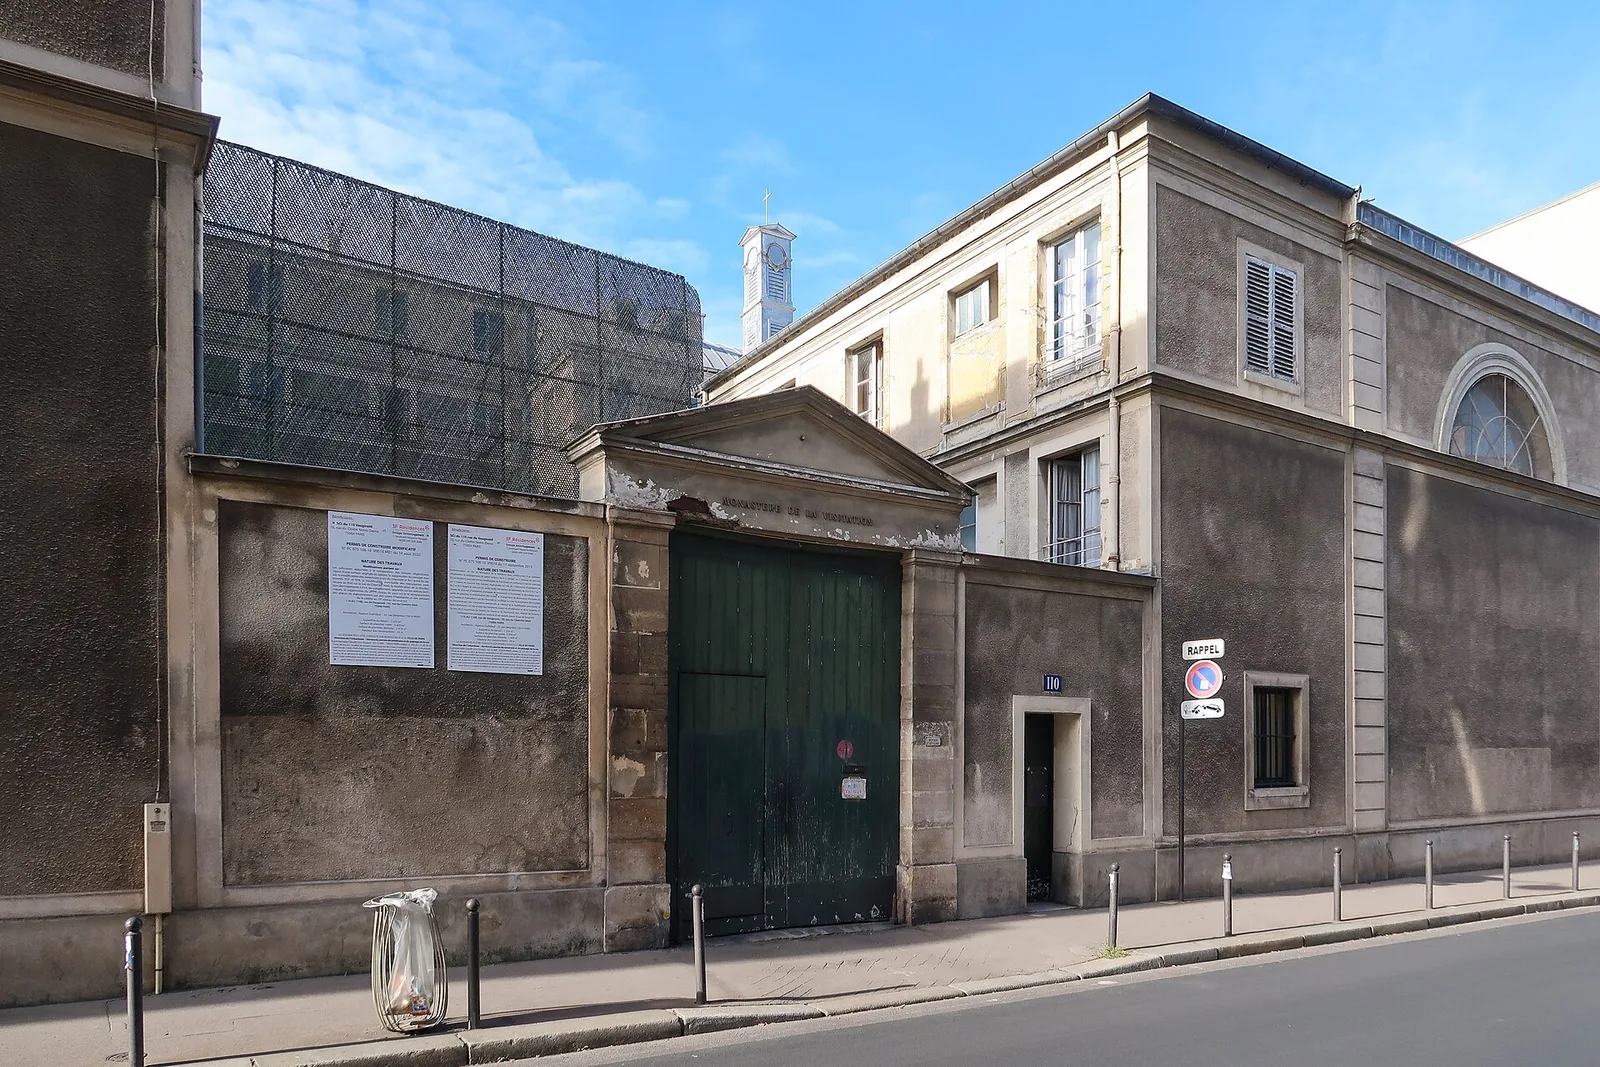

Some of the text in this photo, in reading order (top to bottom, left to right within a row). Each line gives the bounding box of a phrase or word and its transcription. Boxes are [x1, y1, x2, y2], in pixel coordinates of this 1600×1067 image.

[788, 506, 800, 516] DE
[805, 509, 817, 518] LA
[822, 511, 873, 526] VISITATION
[1187, 645, 1219, 655] RAPPEL
[1047, 677, 1059, 690] 110
